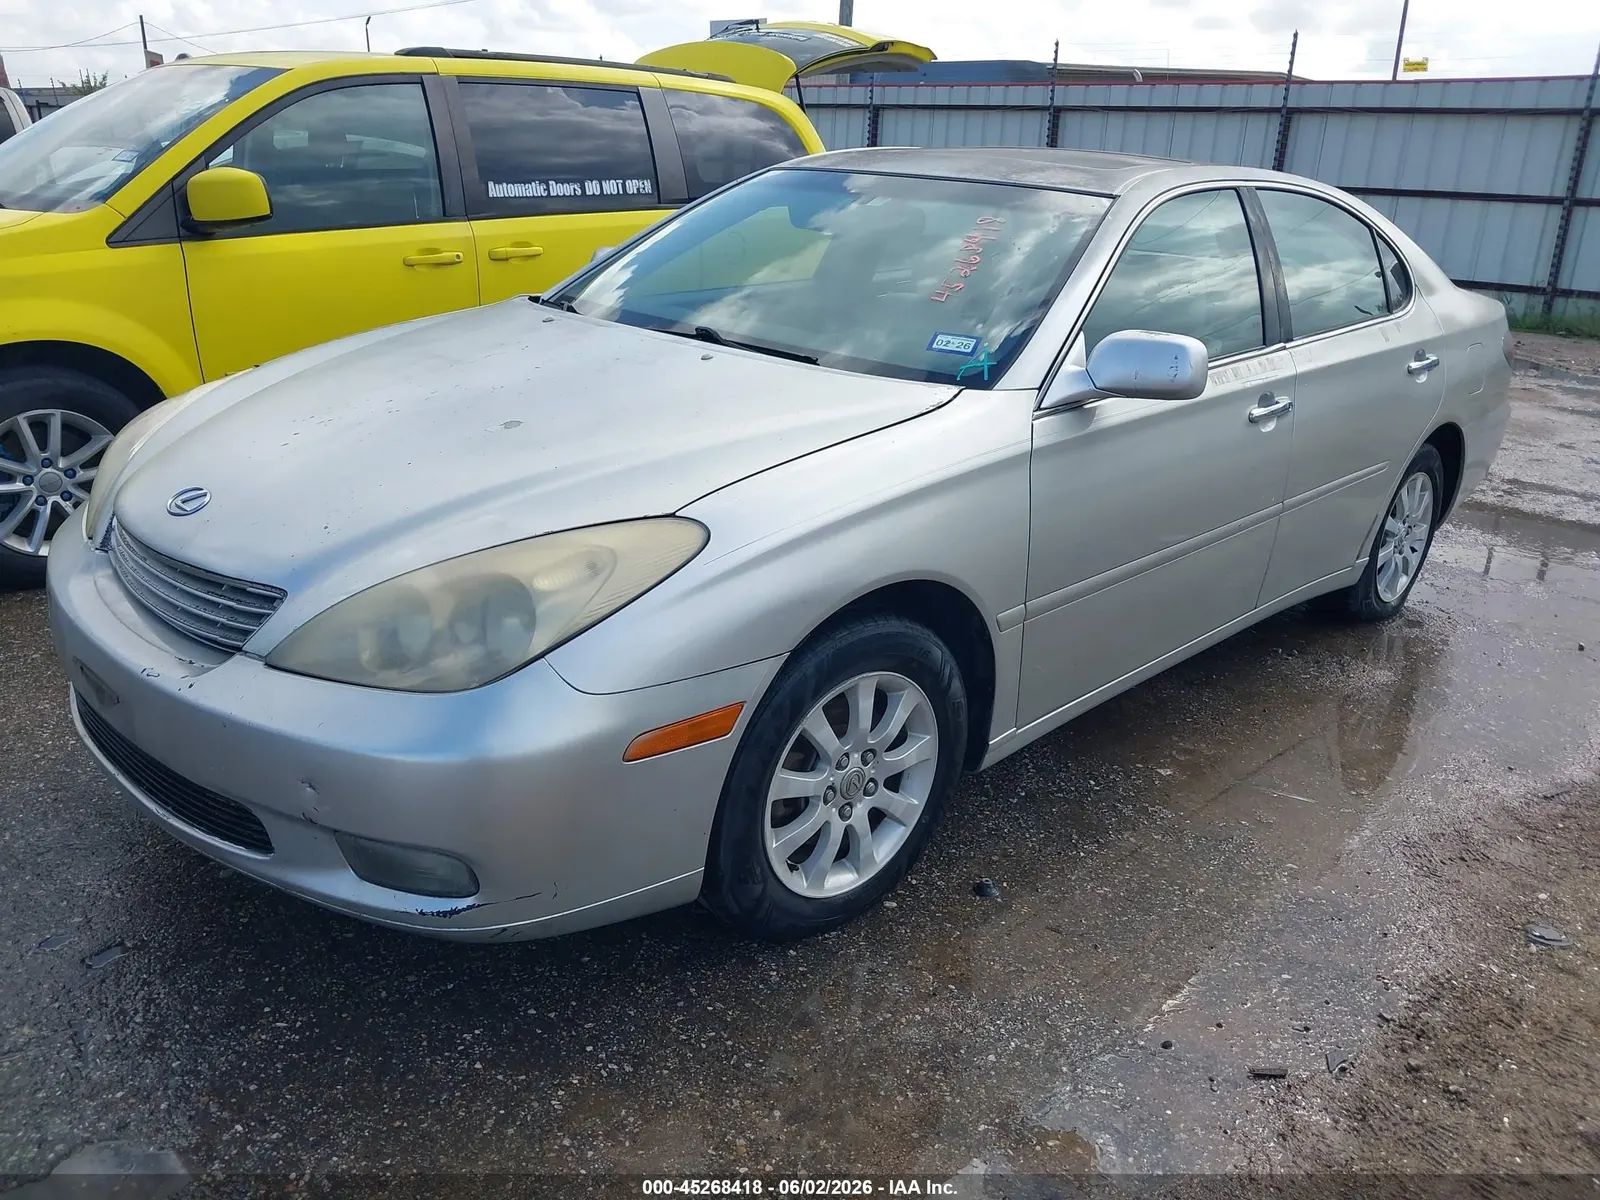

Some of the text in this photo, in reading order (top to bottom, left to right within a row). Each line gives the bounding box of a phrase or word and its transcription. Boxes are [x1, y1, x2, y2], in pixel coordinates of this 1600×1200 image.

[488, 179, 652, 198] Automatic Doors DO NOT OPEN
